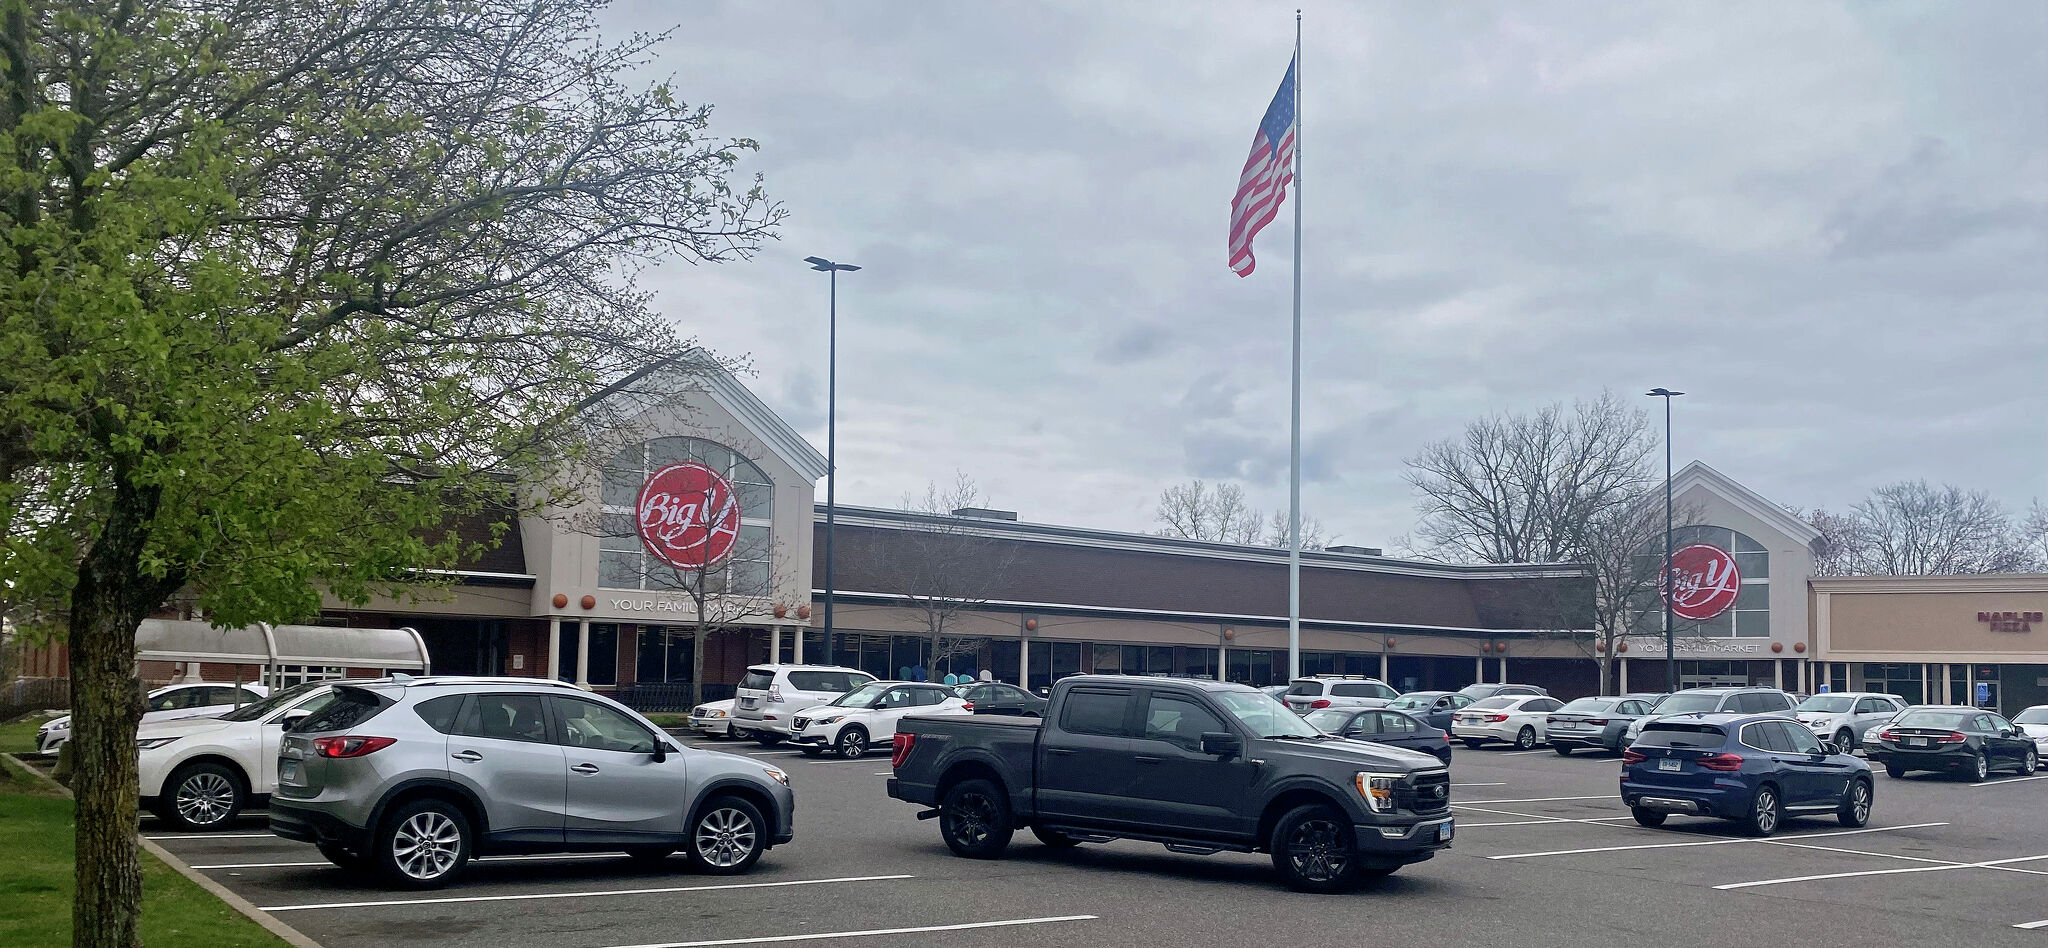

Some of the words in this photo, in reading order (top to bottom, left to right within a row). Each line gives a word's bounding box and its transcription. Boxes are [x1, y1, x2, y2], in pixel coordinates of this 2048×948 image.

[643, 491, 697, 541] Big
[610, 598, 654, 611] YOUR
[1977, 611, 2044, 623] NAPLES
[1713, 644, 1761, 653] MARKET
